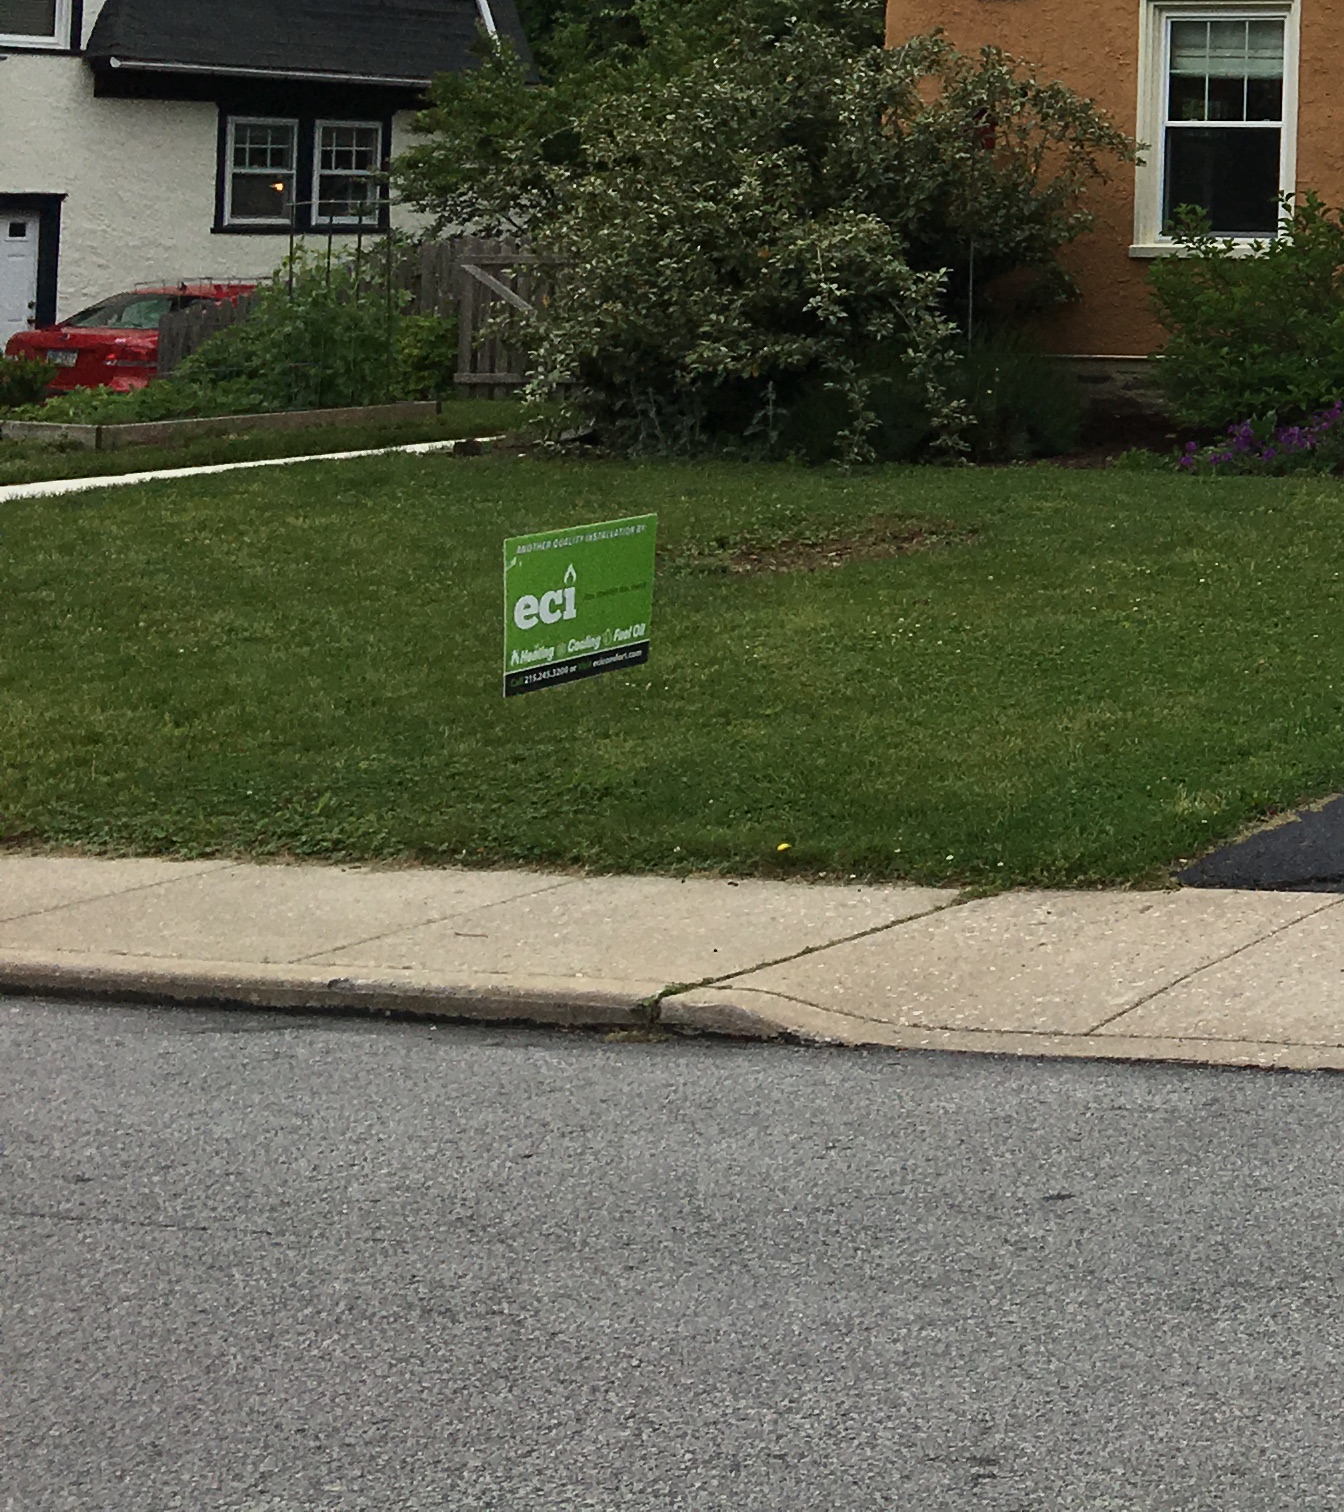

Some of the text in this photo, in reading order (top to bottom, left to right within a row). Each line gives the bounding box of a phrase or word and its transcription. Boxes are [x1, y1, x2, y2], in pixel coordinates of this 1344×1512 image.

[516, 540, 551, 554] ANOTHER
[553, 534, 584, 548] QUALITY
[585, 527, 635, 543] INSTALLATION
[513, 563, 577, 630] eci
[520, 646, 555, 663] Heating
[567, 635, 601, 652] Cooling
[632, 623, 647, 638] Oil
